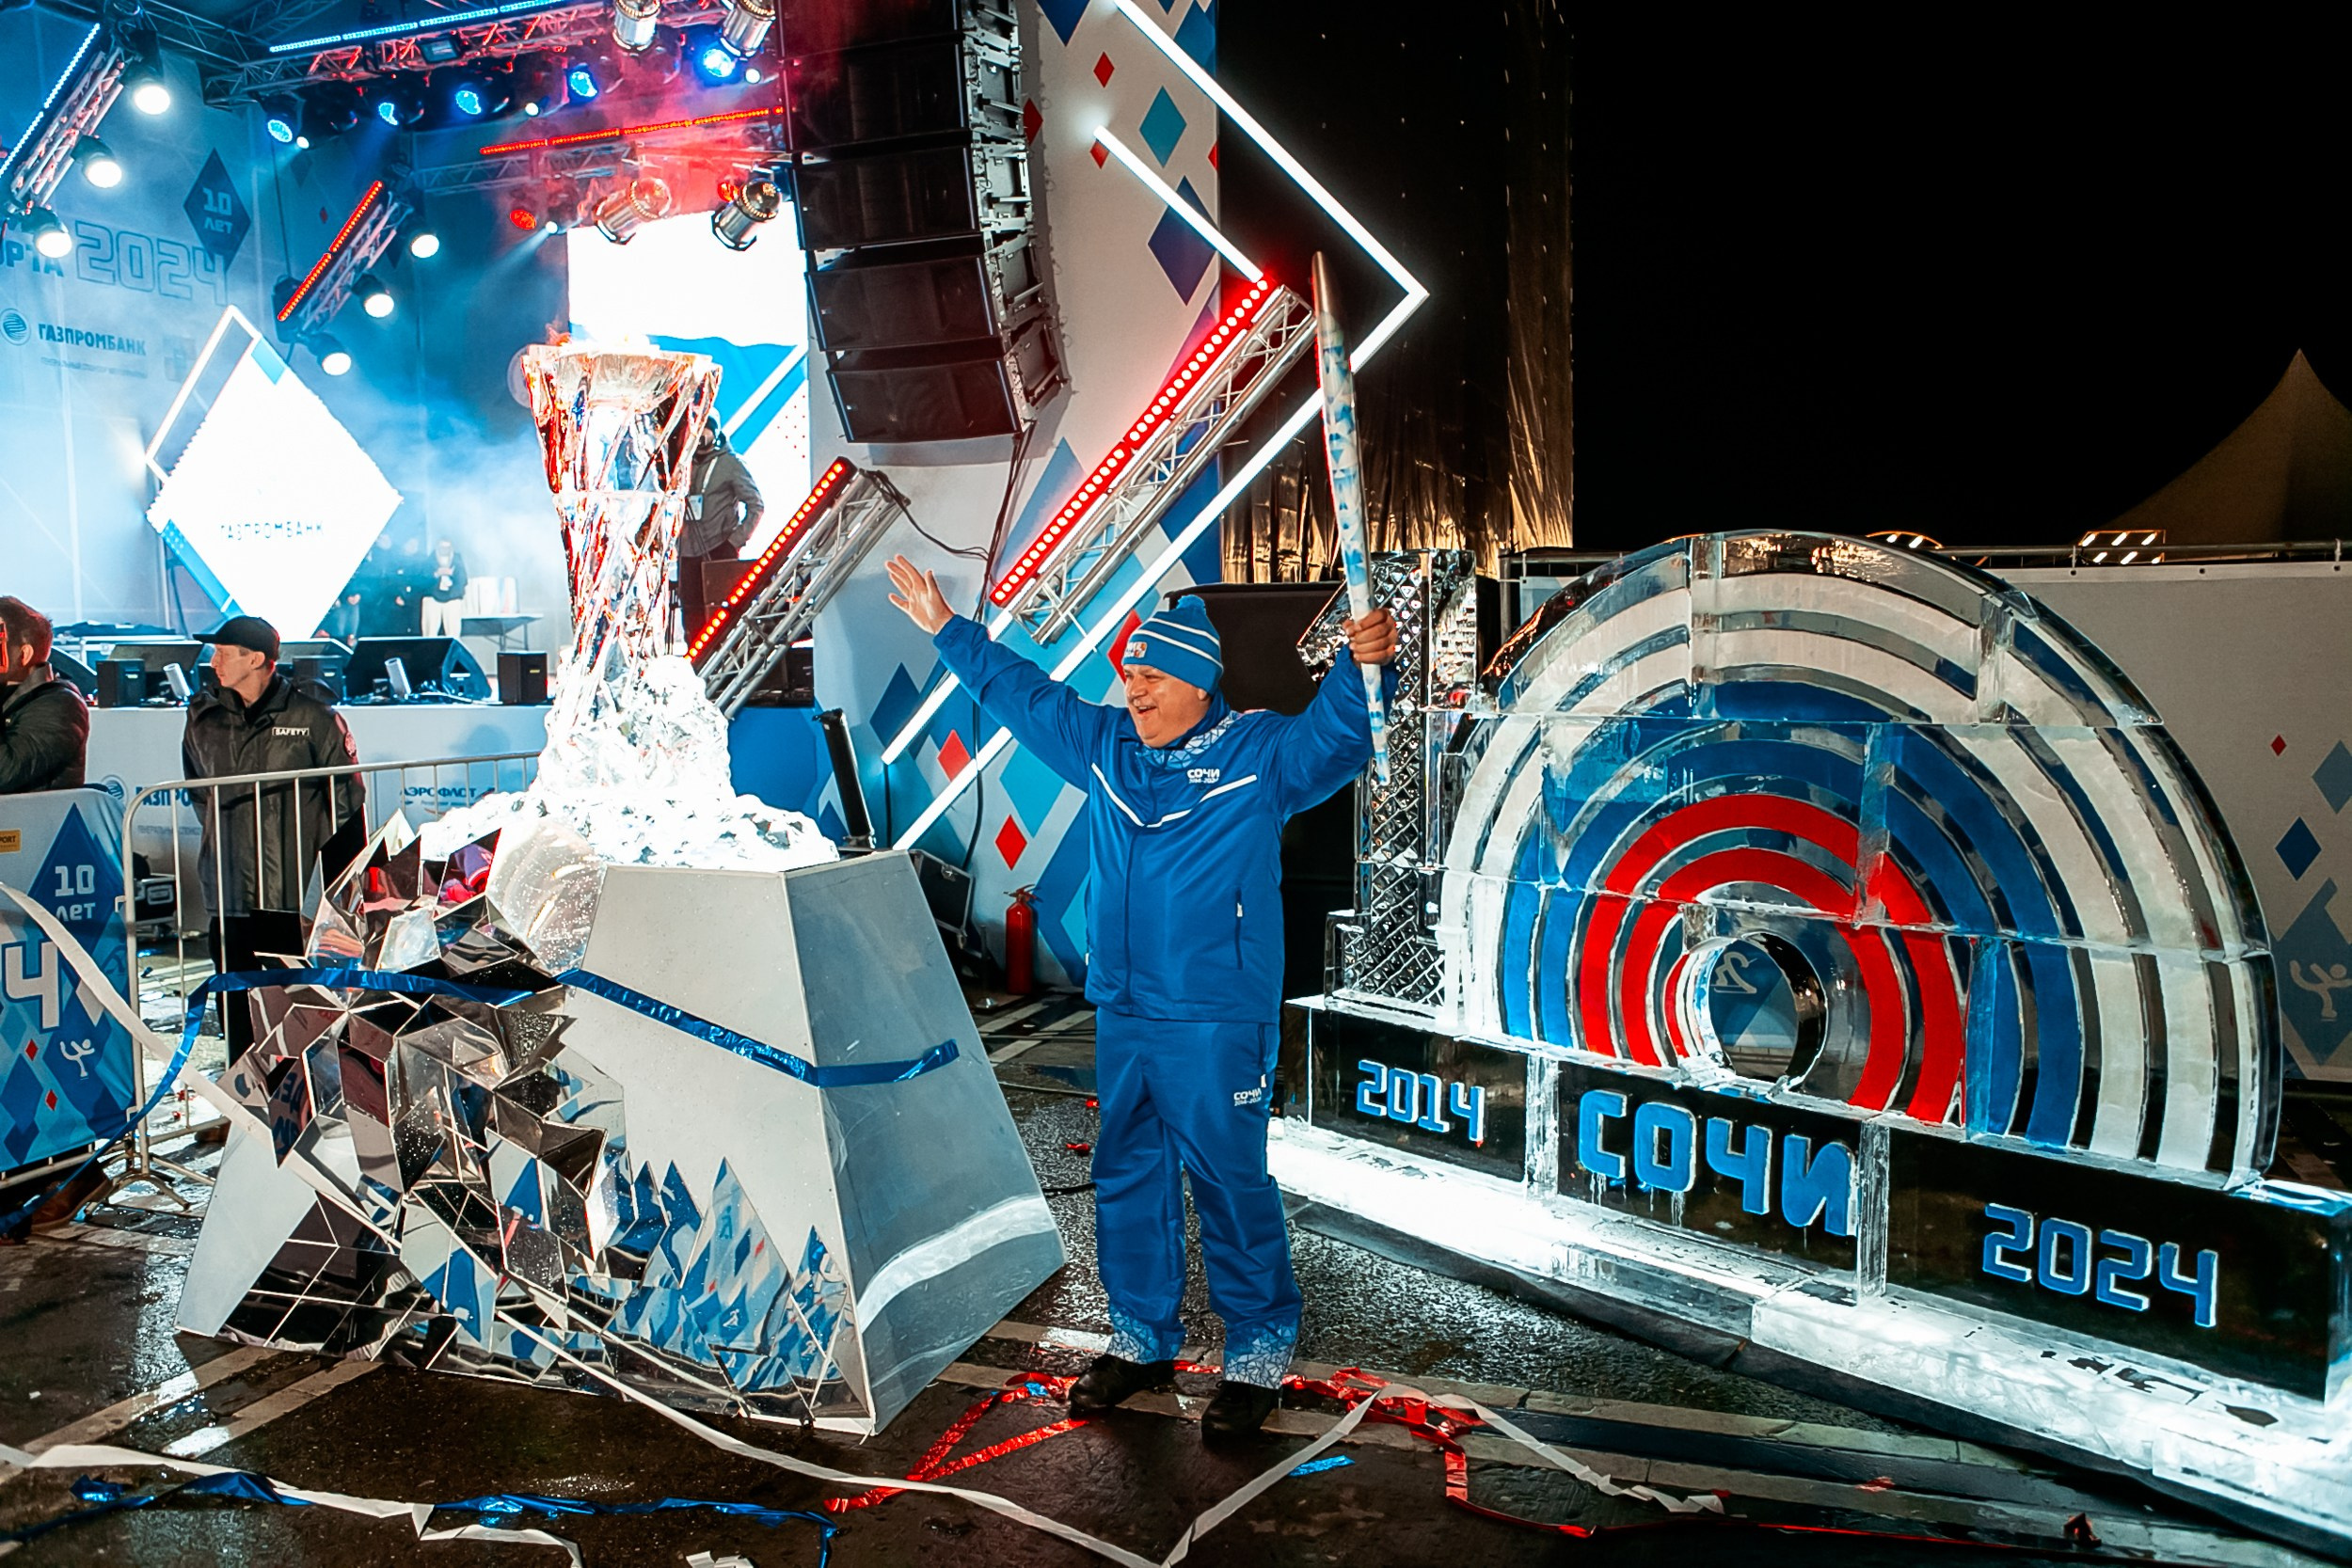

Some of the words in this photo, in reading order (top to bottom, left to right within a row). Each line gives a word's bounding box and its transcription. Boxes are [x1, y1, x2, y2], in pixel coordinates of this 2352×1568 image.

[202, 187, 233, 216] 10
[74, 219, 229, 308] 2024
[39, 323, 147, 356] ГАЗПРОМБАНК
[1187, 768, 1220, 778] СОЧИ
[55, 864, 95, 896] 10
[1234, 1087, 1263, 1100] СОЧИ
[1357, 1060, 1485, 1141] 2014
[1579, 1089, 1857, 1237] СОЧИ
[1982, 1202, 2218, 1328] 2024
